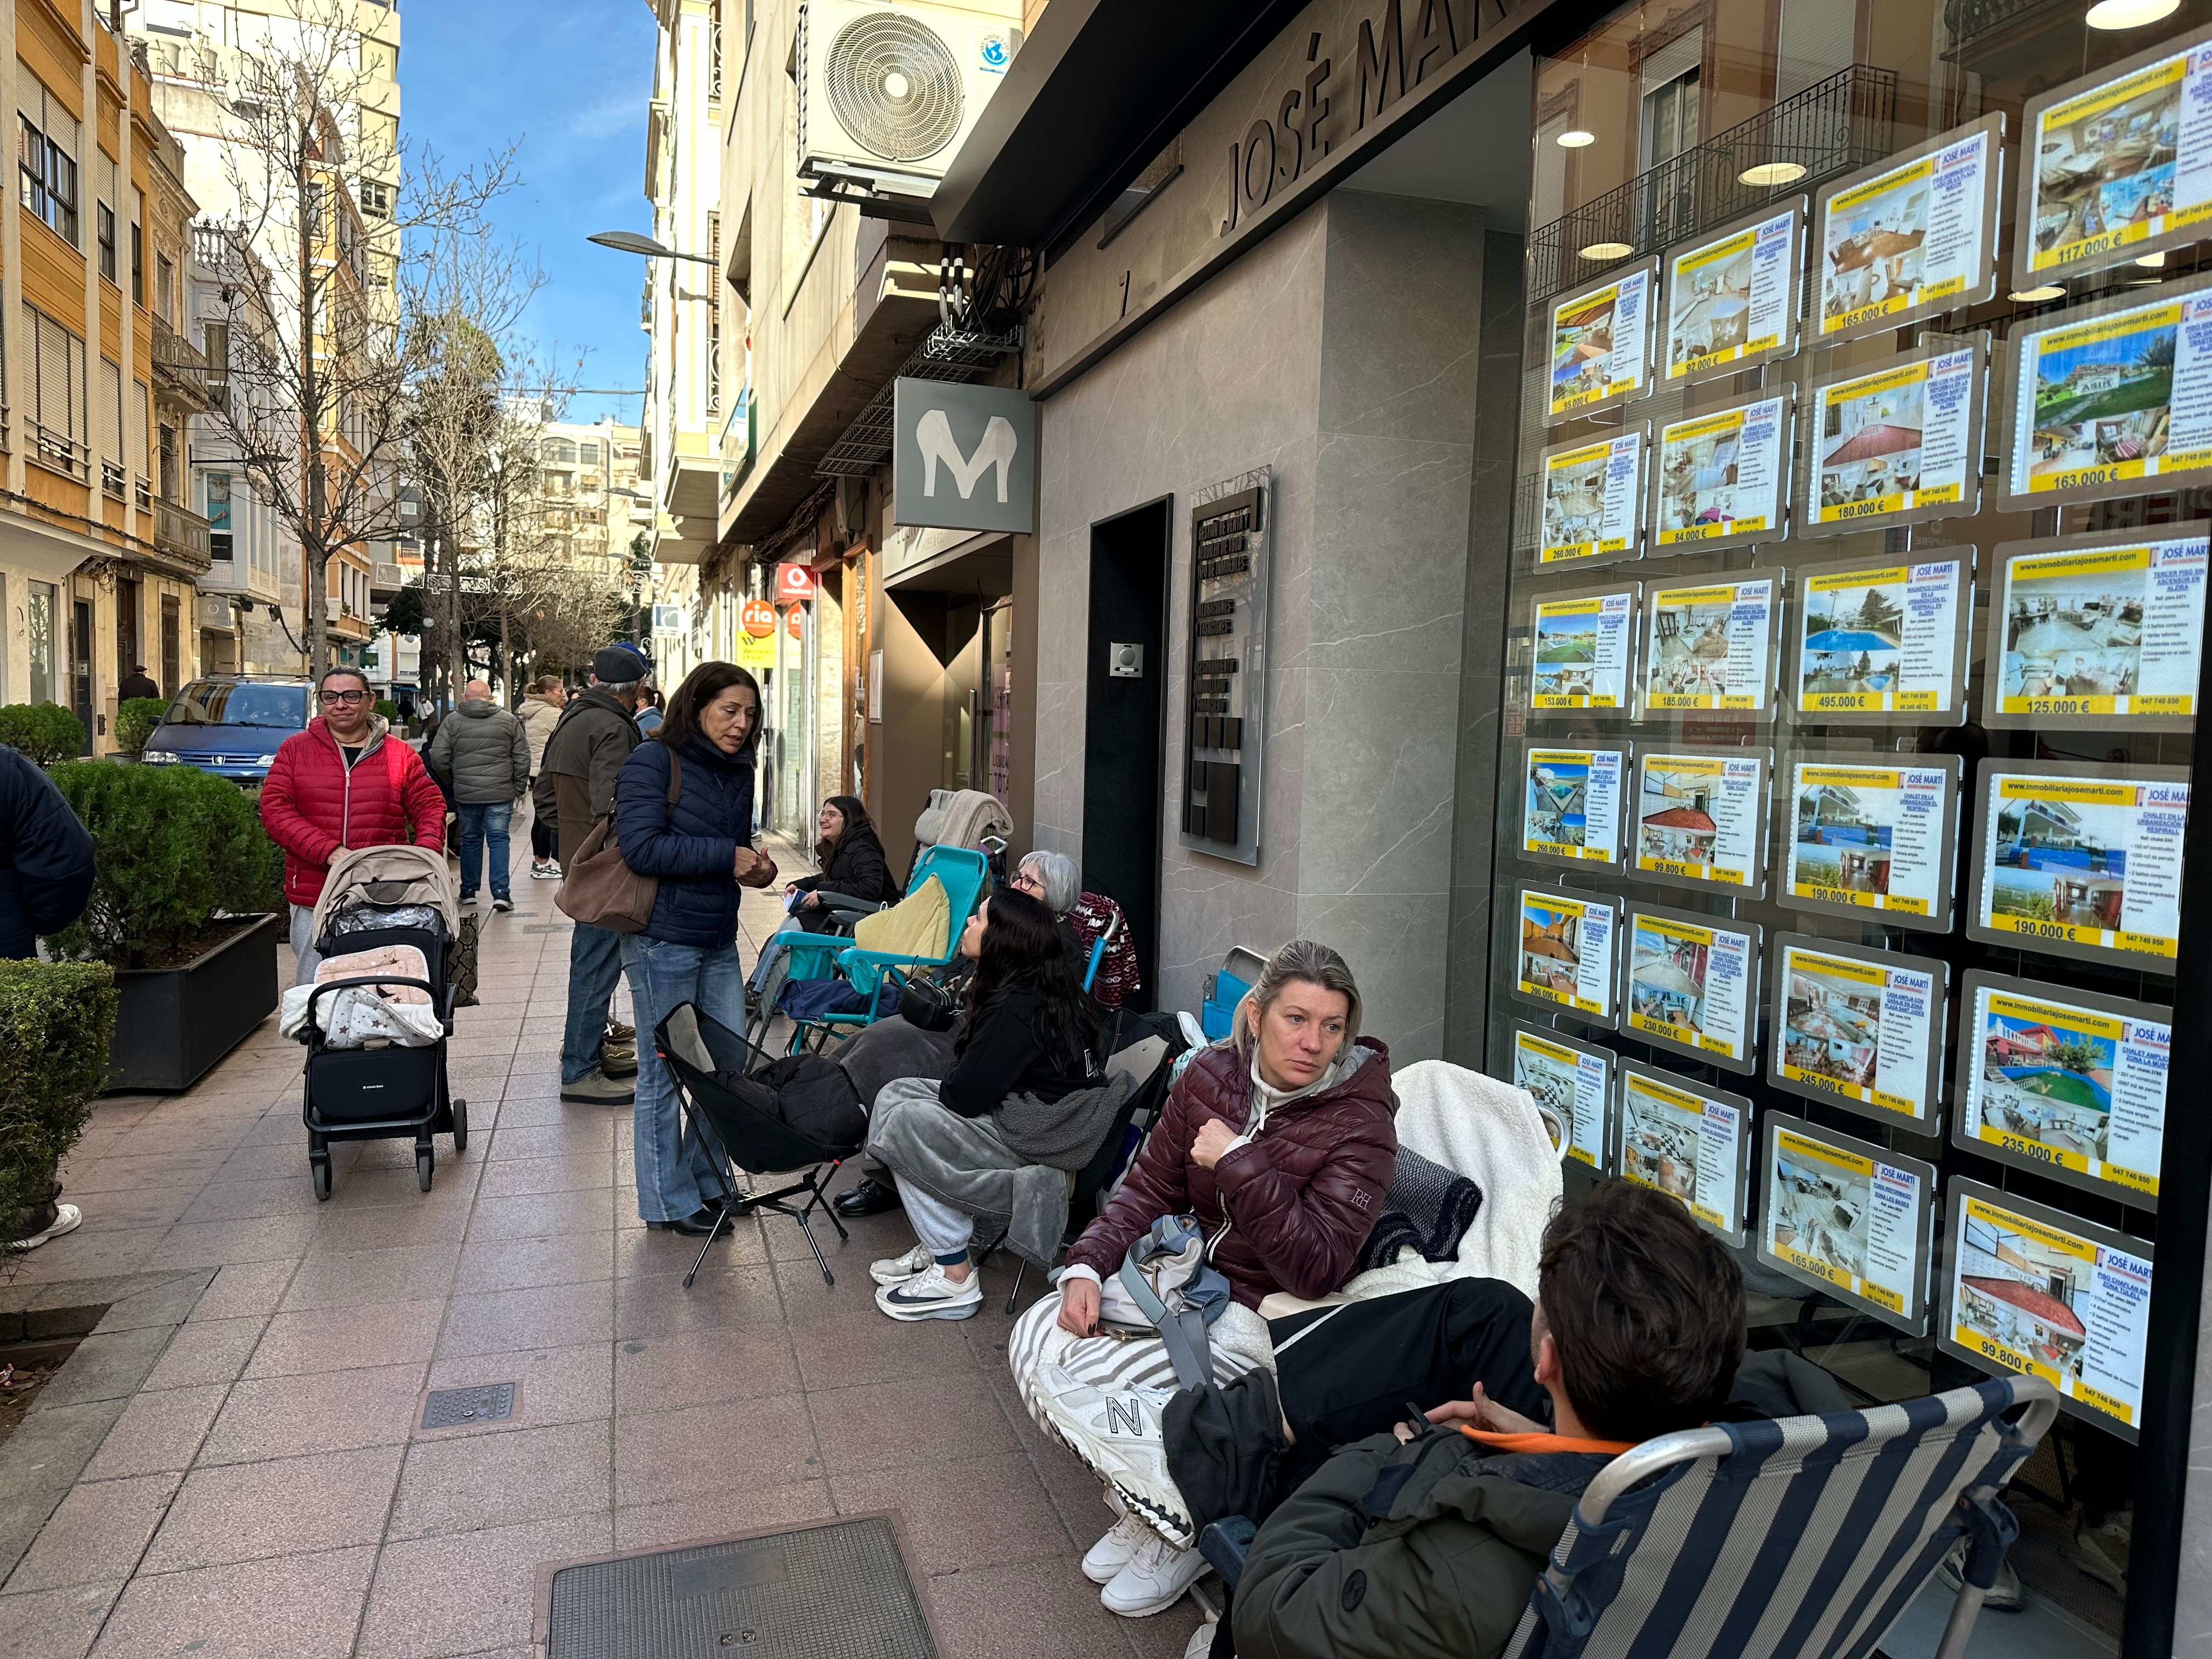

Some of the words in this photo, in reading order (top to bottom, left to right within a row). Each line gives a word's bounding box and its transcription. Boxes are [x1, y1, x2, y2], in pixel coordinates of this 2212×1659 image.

[1220, 32, 1330, 238] JOSÉ
[1942, 148, 1958, 164] JOSÉ
[1960, 138, 1980, 159] MARTÍ
[2058, 237, 2108, 263] 117.000
[2114, 233, 2122, 246] €
[1842, 307, 1879, 328] 165.000
[1882, 303, 1888, 314] €
[1686, 358, 1711, 373] 92.000
[1713, 355, 1719, 364] €
[1937, 356, 1953, 369] JOSÉ
[1564, 397, 1583, 411] 95.000
[1584, 394, 1589, 403] €
[2054, 471, 2105, 489] 163.000
[2109, 468, 2118, 481] €
[1838, 501, 1875, 519] 180.000
[1878, 500, 1884, 511] €
[1674, 530, 1700, 542] 84.000
[1701, 528, 1707, 538] €
[1553, 548, 1576, 559] 260.000
[1577, 546, 1582, 556] €
[2162, 545, 2183, 560] JOSÉ
[1916, 565, 1931, 576] JOSÉ
[1933, 562, 1952, 574] MARTÍ
[2154, 571, 2177, 579] TERCER
[2157, 578, 2191, 586] ASCENSOR
[745, 604, 772, 623] ria
[1545, 697, 1566, 706] 153.000
[1568, 697, 1572, 706] €
[1663, 697, 1691, 707] 185.000
[1693, 697, 1699, 707] €
[1819, 697, 1855, 707] 495.000
[1859, 696, 1865, 706] €
[2027, 701, 2077, 713] 125.000
[2081, 701, 2090, 713] €
[994, 772, 1008, 794] TOTA
[1907, 772, 1922, 784] JOSÉ
[1923, 773, 1943, 784] MARTÍ
[2148, 788, 2169, 801] JOSÉ
[2137, 819, 2181, 827] URBANIZACIÓN
[1537, 844, 1560, 854] 260.000
[1561, 847, 1566, 855] €
[1655, 862, 1678, 874] 99.800
[1681, 866, 1686, 875] €
[1812, 888, 1847, 903] 190.000
[1850, 893, 1857, 904] €
[2014, 920, 2063, 939] 190.000
[2067, 928, 2075, 940] €
[1894, 974, 1908, 985] JOSÉ
[1910, 978, 1928, 989] MARTÍ
[1531, 986, 1553, 1001] 200.000
[1644, 1020, 1671, 1037] 230.000
[1674, 1029, 1678, 1039] €
[2134, 1026, 2155, 1041] JOSÉ
[2123, 1047, 2146, 1057] CHALET
[2126, 1055, 2141, 1064] ZONA
[1800, 1073, 1835, 1092] 245.000
[1838, 1084, 1844, 1094] €
[2002, 1136, 2051, 1161] 235.000
[2055, 1153, 2063, 1165] €
[1881, 1166, 1895, 1178] JOSÉ
[1897, 1172, 1915, 1184] MARTÍ
[2113, 1167, 2124, 1175] 647
[2125, 1170, 2137, 1180] 740
[2138, 1175, 2150, 1184] 850
[1791, 1253, 1825, 1276] 165.000
[1828, 1269, 1834, 1280] €
[2107, 1254, 2128, 1269] JOSÉ
[2097, 1272, 2111, 1283] PISO
[2141, 1287, 2148, 1295] EN
[2102, 1281, 2118, 1290] ZONA
[2119, 1286, 2141, 1300] TULELL
[1982, 1341, 2021, 1369] 99.800
[2025, 1363, 2033, 1374] €
[2085, 1387, 2095, 1396] 647
[2097, 1393, 2108, 1403] 740
[2109, 1399, 2120, 1409] 850
